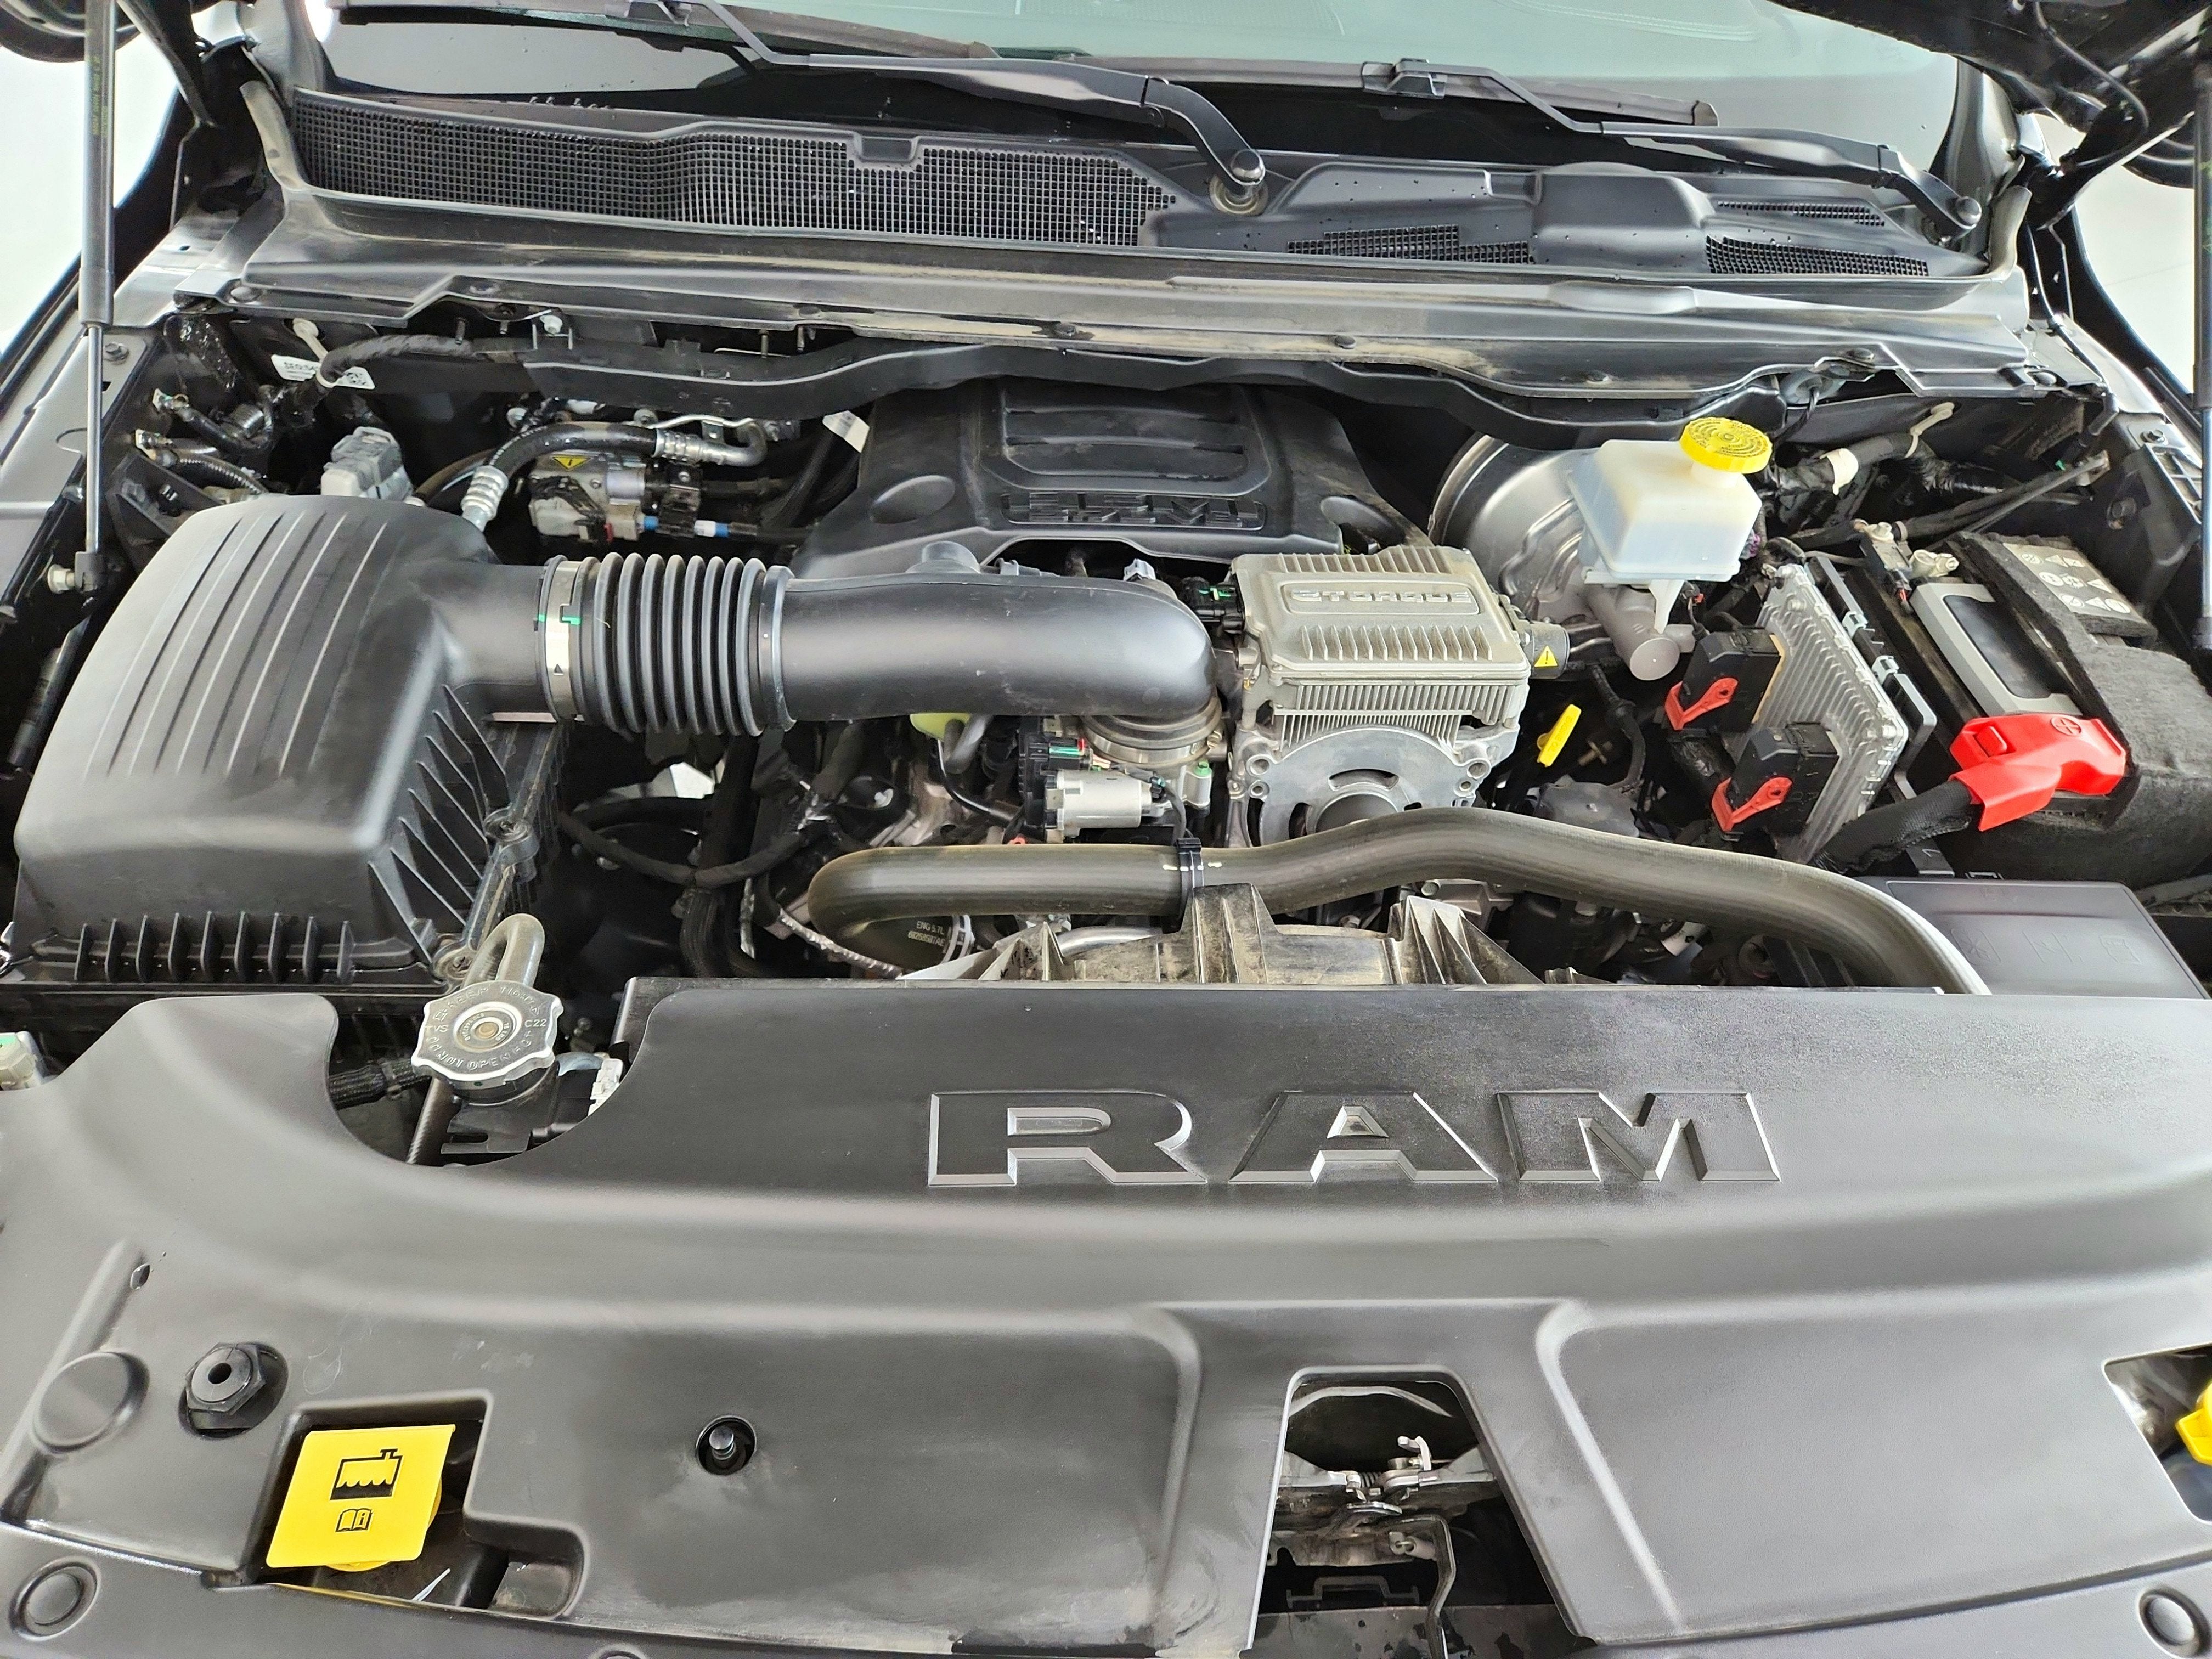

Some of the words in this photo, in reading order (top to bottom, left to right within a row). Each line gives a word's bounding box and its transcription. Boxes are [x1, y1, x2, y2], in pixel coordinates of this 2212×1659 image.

[916, 921, 930, 931] ENG
[932, 924, 945, 935] 5.7L
[448, 988, 489, 1008] KEEP
[425, 1024, 449, 1032] TVS
[524, 1019, 547, 1028] C22
[468, 1053, 512, 1070] OPEN
[928, 1091, 1782, 1185] RAM
